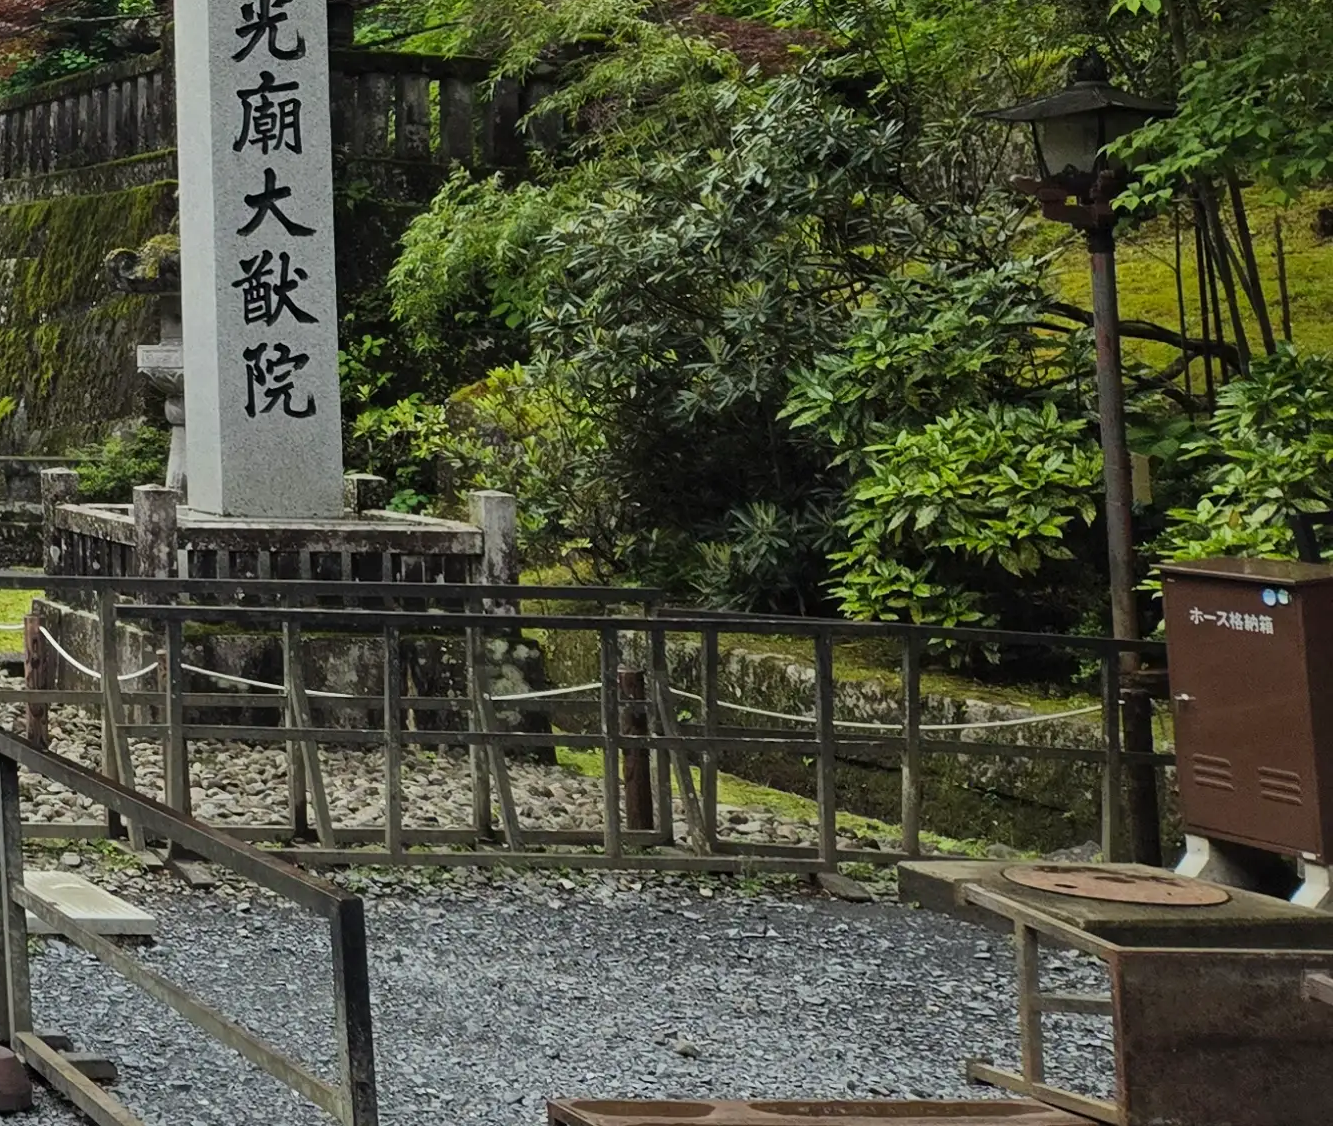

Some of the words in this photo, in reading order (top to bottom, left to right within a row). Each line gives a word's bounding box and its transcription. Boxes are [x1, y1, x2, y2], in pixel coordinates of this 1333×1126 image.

[1189, 606, 1274, 634] ホース格納箱
